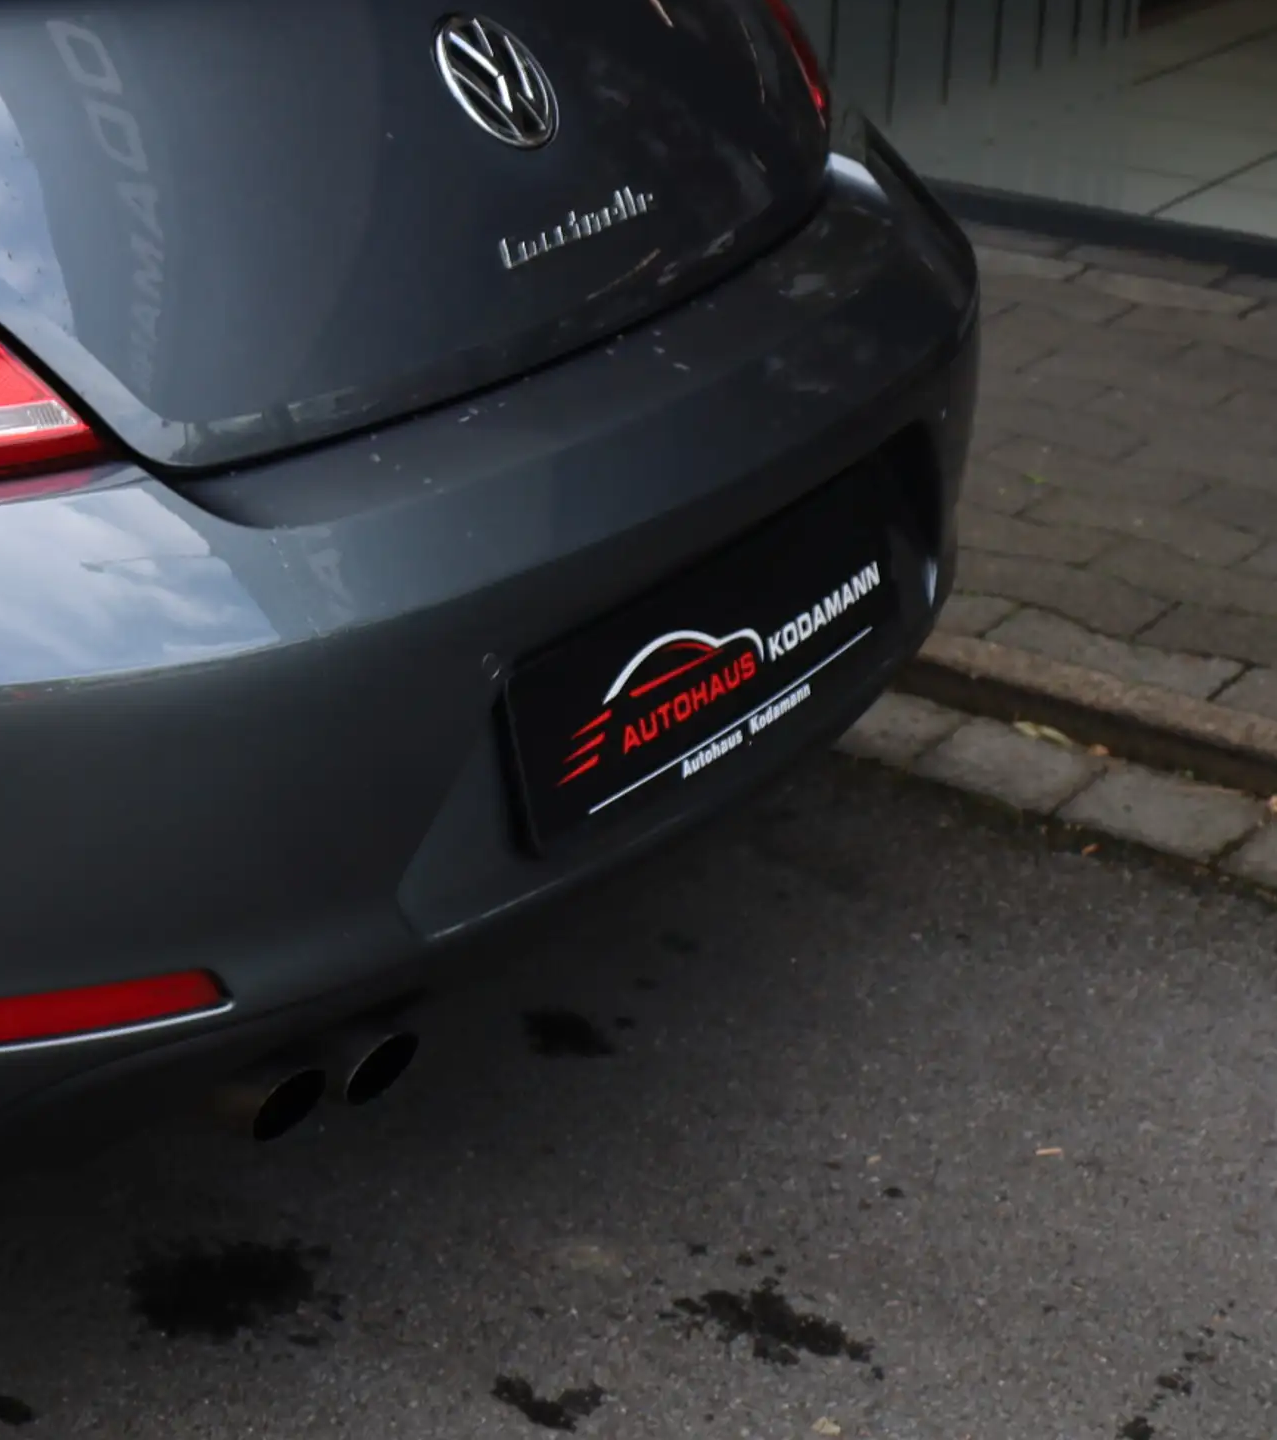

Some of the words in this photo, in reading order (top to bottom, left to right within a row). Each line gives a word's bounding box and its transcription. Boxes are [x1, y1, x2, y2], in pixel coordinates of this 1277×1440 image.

[623, 651, 757, 754] AUTOHAUS
[767, 561, 881, 661] KODAMANN
[681, 728, 743, 780] Autohaus
[749, 683, 812, 735] Kodamann
